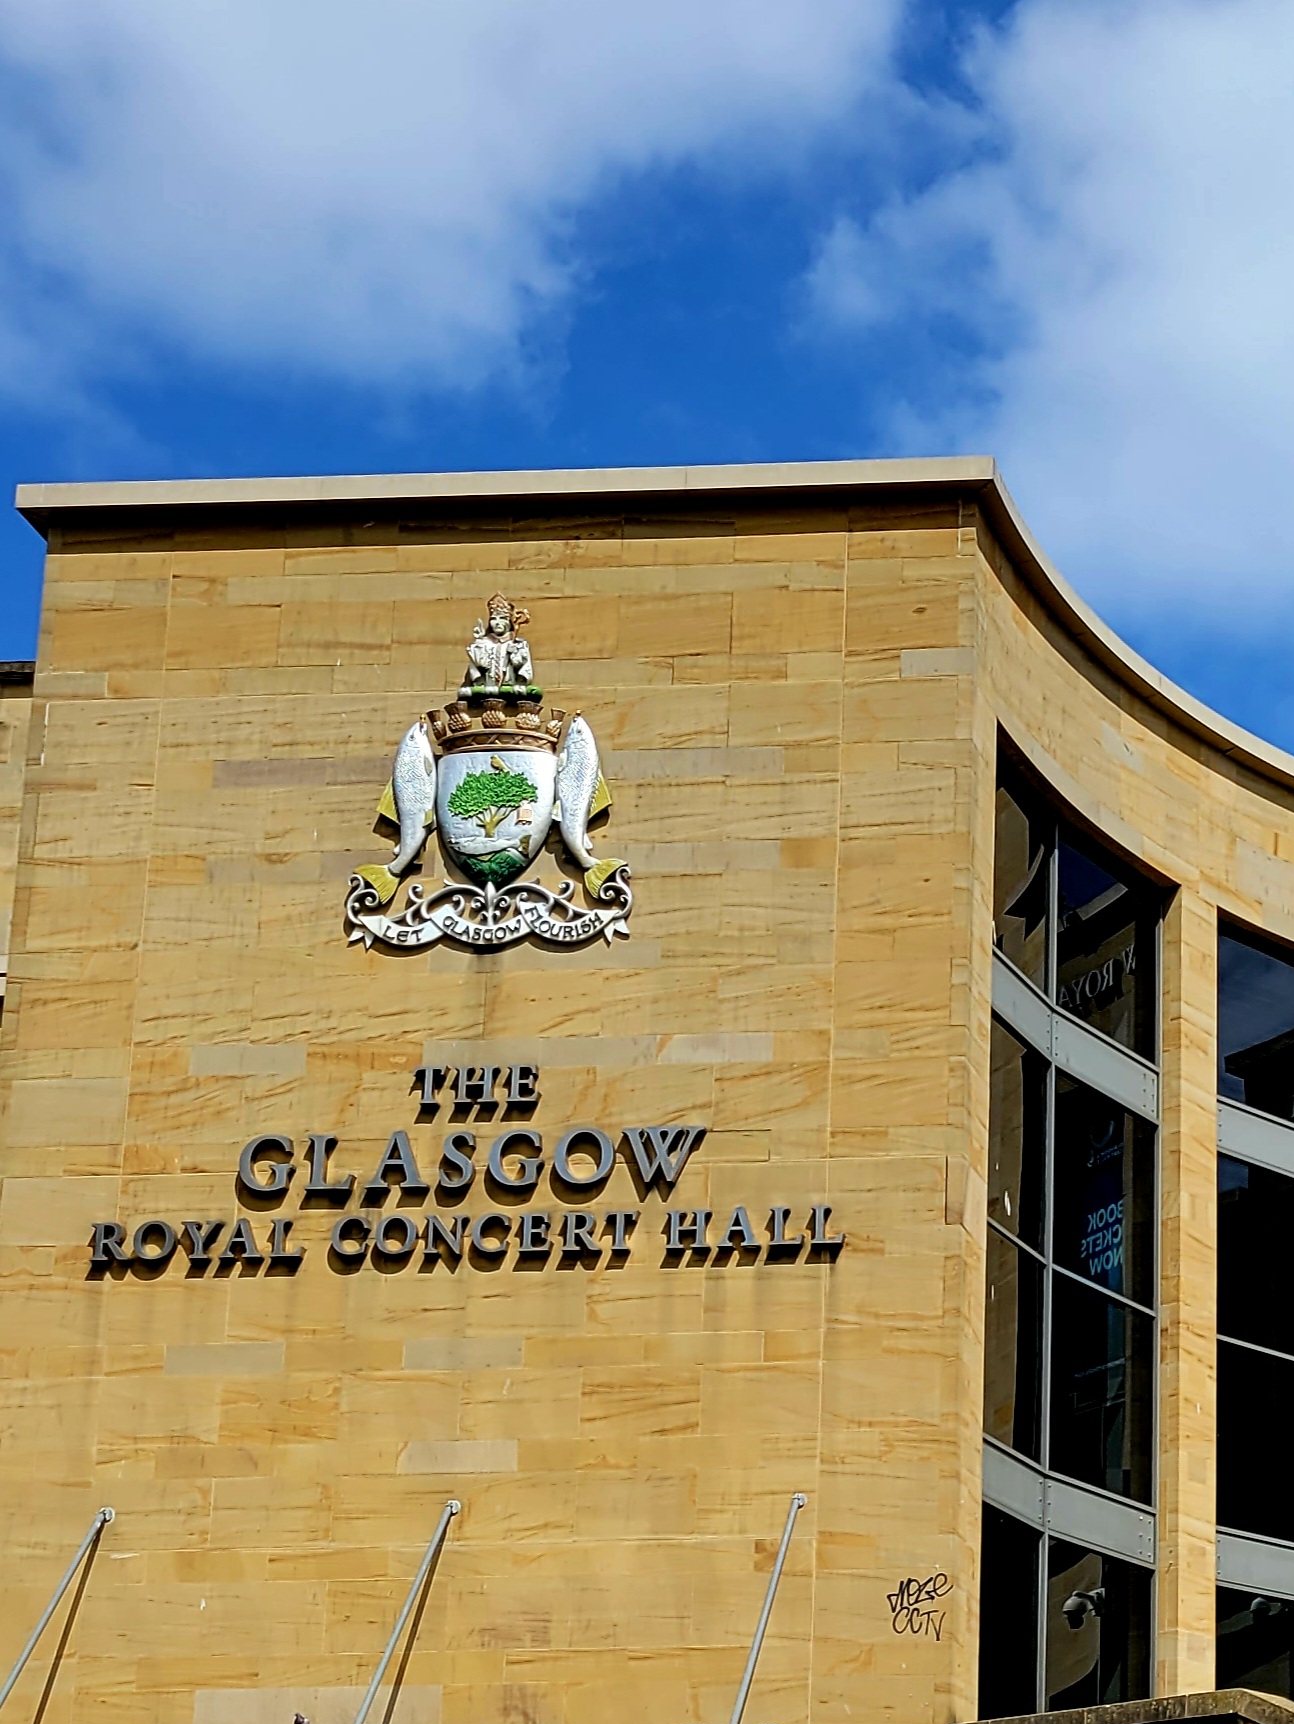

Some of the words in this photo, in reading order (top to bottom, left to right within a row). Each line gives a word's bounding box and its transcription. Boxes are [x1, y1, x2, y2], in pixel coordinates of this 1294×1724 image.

[383, 925, 424, 942] LET
[442, 915, 522, 942] GLASGOW
[524, 905, 604, 940] FLOURISH
[413, 1065, 541, 1104] THE
[237, 1125, 708, 1193] GLASGOW
[90, 1217, 304, 1262] ROYAL
[331, 1210, 641, 1257] CONCERT
[664, 1205, 846, 1250] HALL
